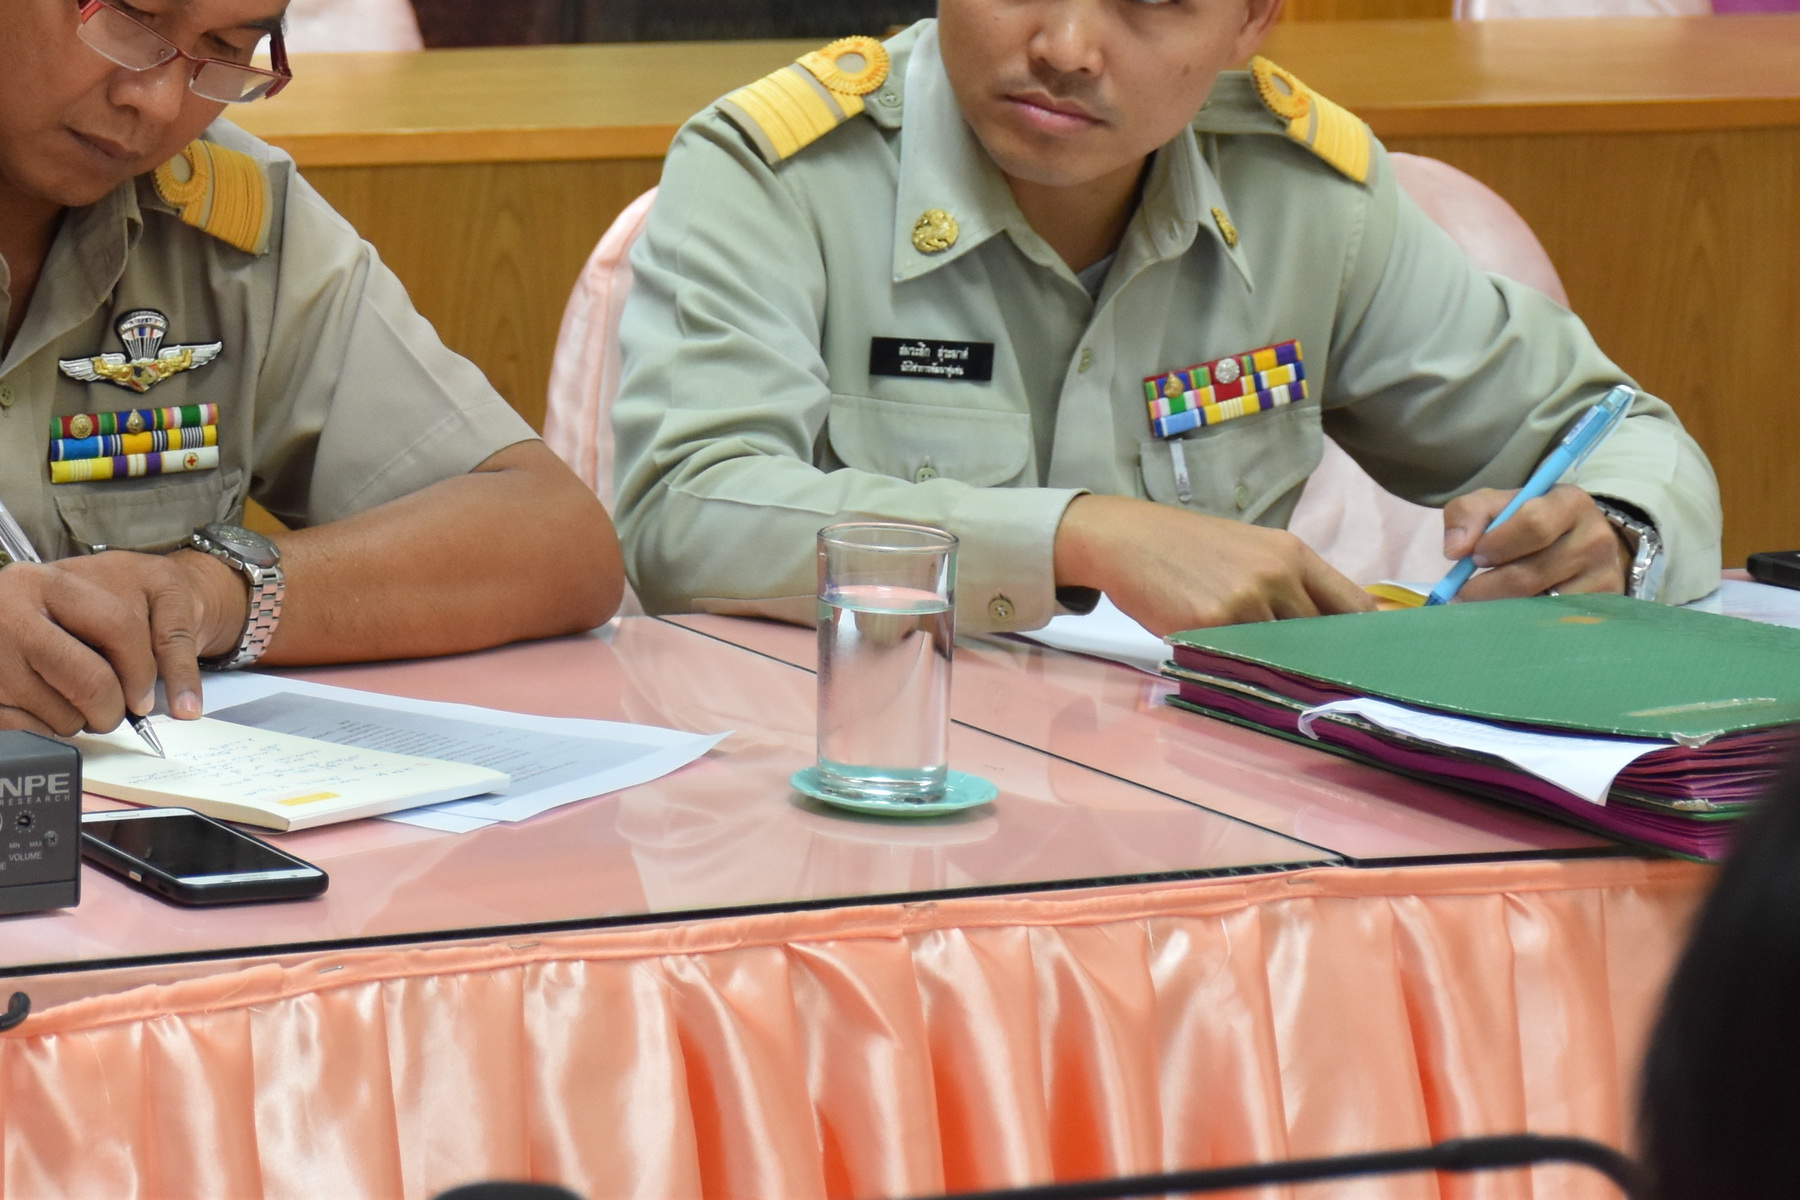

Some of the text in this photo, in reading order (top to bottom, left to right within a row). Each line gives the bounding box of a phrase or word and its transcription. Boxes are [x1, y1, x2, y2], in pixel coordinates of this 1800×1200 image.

[0, 772, 71, 798] NPE
[29, 840, 44, 848] MAX
[8, 851, 42, 862] VOLUME
